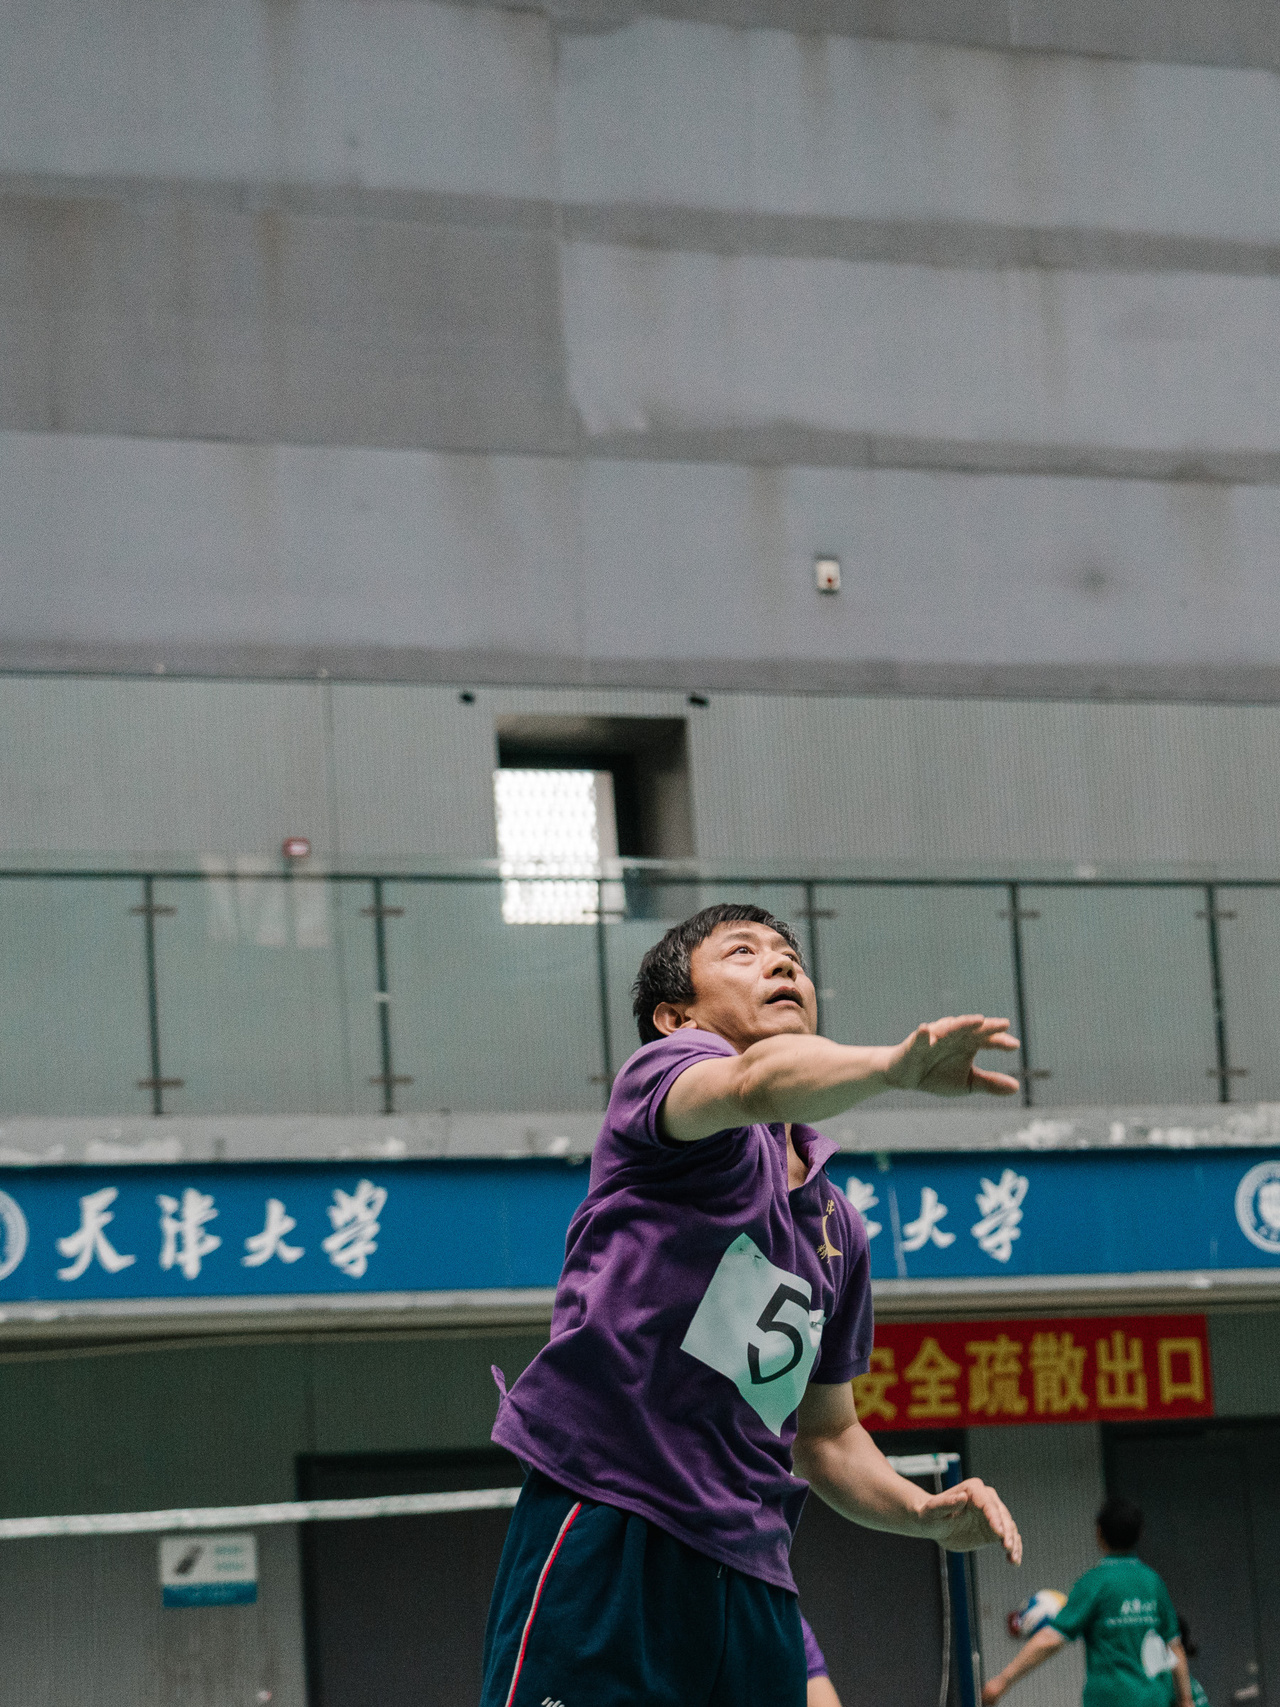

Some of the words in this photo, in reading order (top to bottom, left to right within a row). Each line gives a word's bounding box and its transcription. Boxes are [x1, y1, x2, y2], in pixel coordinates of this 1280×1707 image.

[56, 1179, 388, 1281] 天津大学
[747, 1283, 810, 1385] 5
[851, 1330, 1205, 1422] 安全疏散出口
